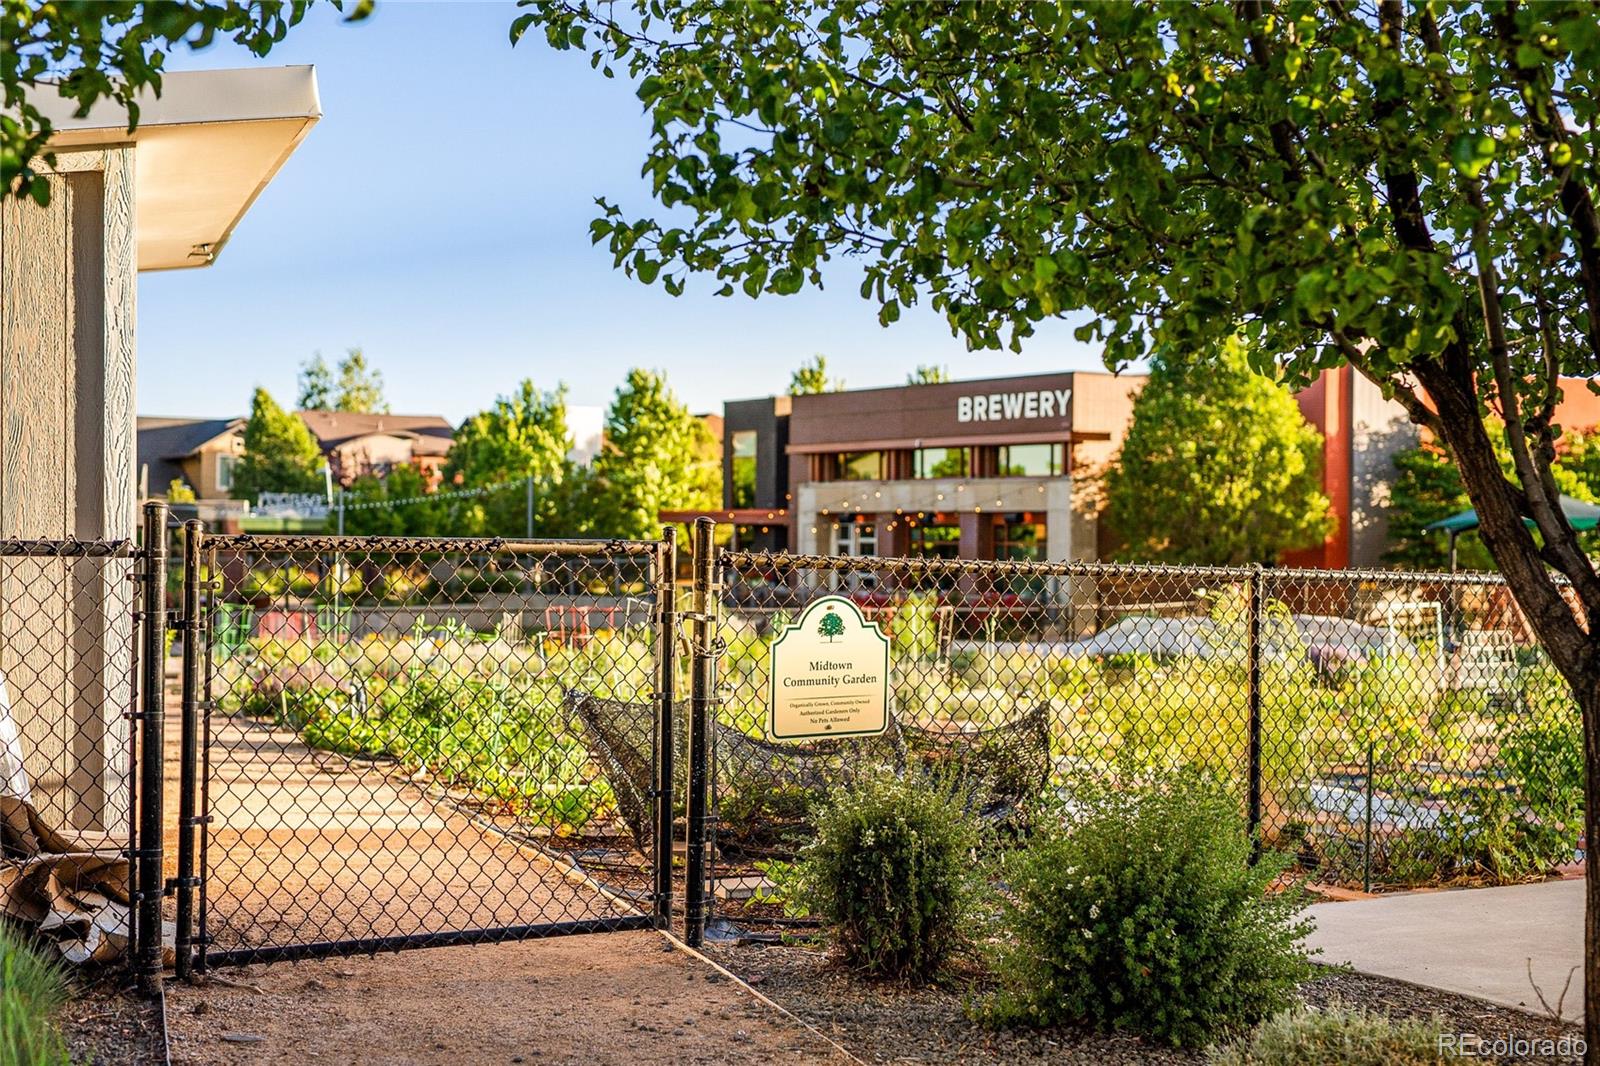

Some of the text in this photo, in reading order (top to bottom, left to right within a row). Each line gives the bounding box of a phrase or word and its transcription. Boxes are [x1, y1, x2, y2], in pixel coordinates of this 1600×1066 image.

[957, 389, 1071, 422] BREWERY
[809, 661, 853, 671] Midtown
[783, 674, 877, 688] Community Garden
